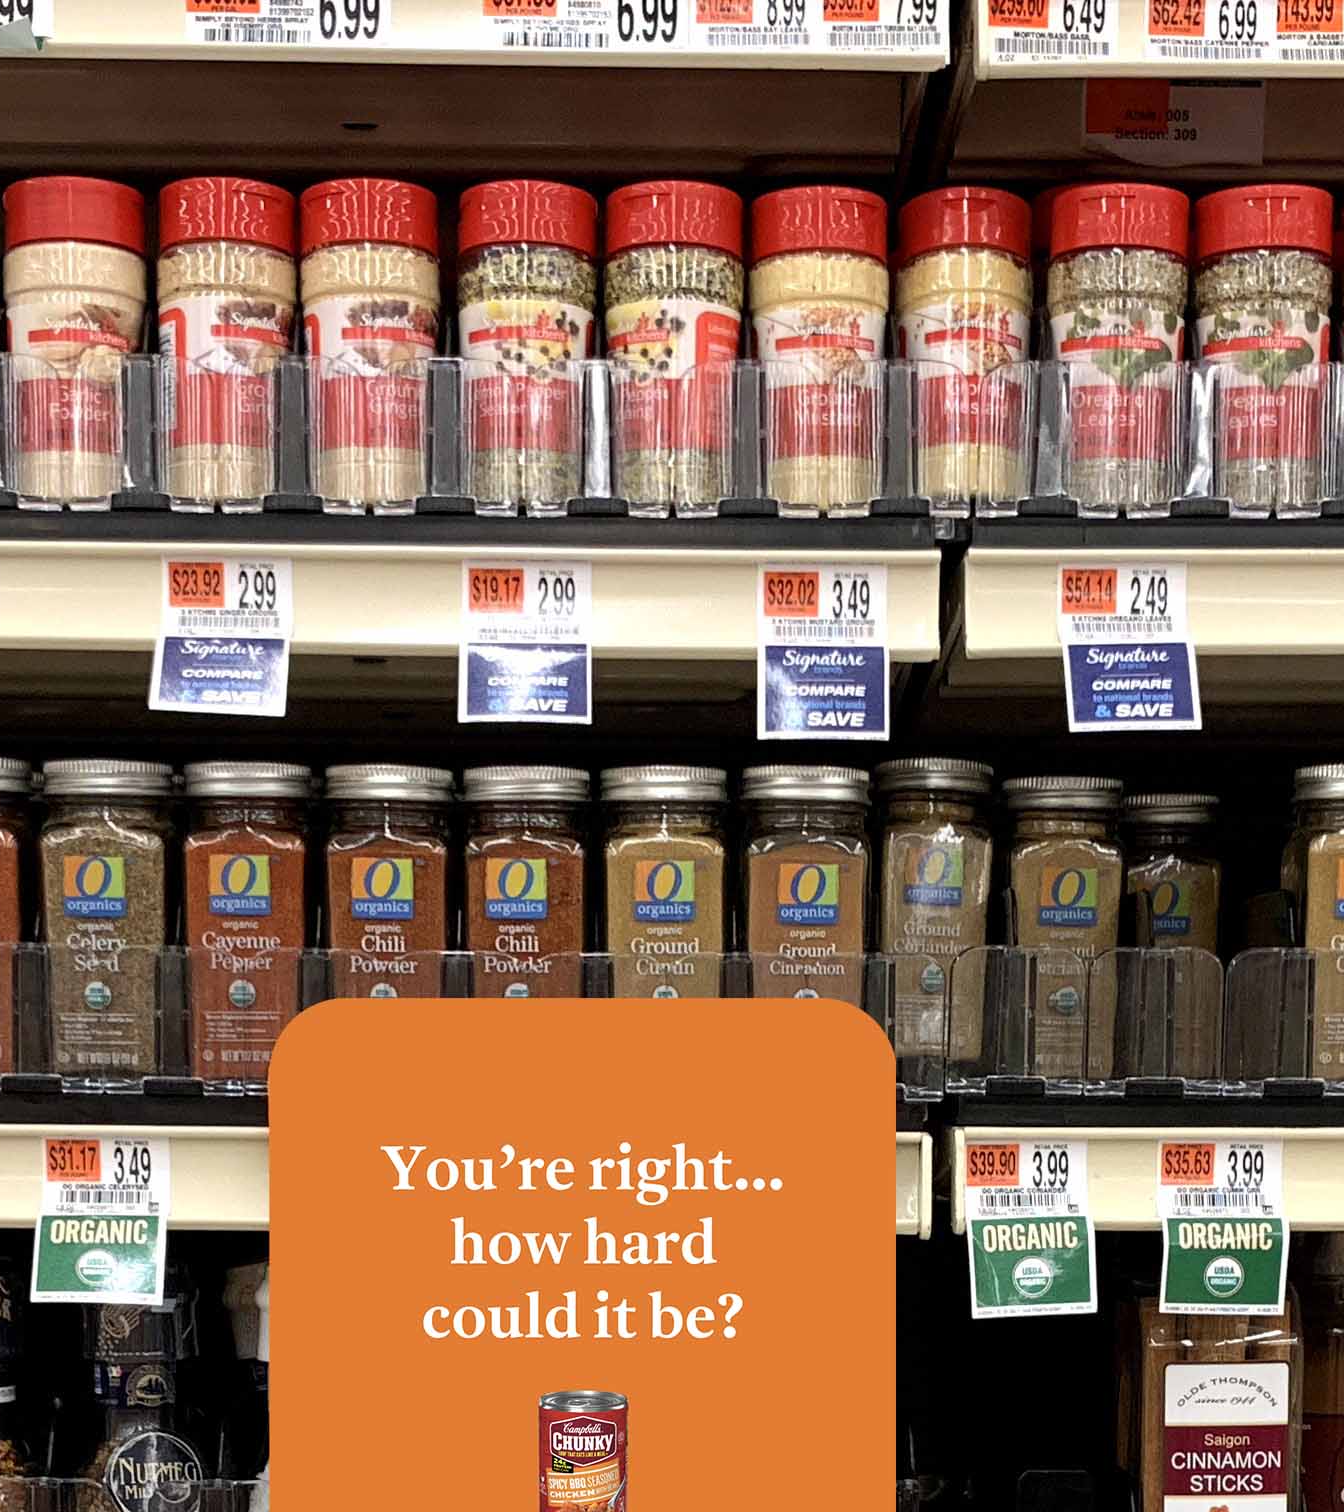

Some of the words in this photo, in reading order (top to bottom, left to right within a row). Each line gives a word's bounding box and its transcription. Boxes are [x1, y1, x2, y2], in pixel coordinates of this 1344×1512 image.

[1218, 0, 1258, 40] 6.99
[1174, 128, 1197, 141] 309
[767, 578, 815, 607] $32.02
[832, 577, 871, 619] 3.49
[1065, 575, 1113, 604] $54.14
[1130, 576, 1168, 615] 2.49
[1086, 647, 1170, 667] Signature
[1092, 678, 1172, 690] COMPARE
[1093, 693, 1103, 702] to
[1106, 692, 1145, 702] national
[1147, 692, 1173, 701] brands
[1095, 704, 1112, 717] &
[1116, 702, 1173, 718] SAVE
[361, 936, 405, 952] Chili
[350, 956, 415, 976] Powder
[970, 1149, 1016, 1178] $39.90
[1032, 1149, 1068, 1188] 3.99
[1178, 1222, 1272, 1250] ORGANIC
[1210, 1267, 1235, 1275] USDA
[1204, 1433, 1251, 1448] Saigon
[1171, 1451, 1281, 1470] CINNAMON
[1189, 1473, 1263, 1492] STICKS
